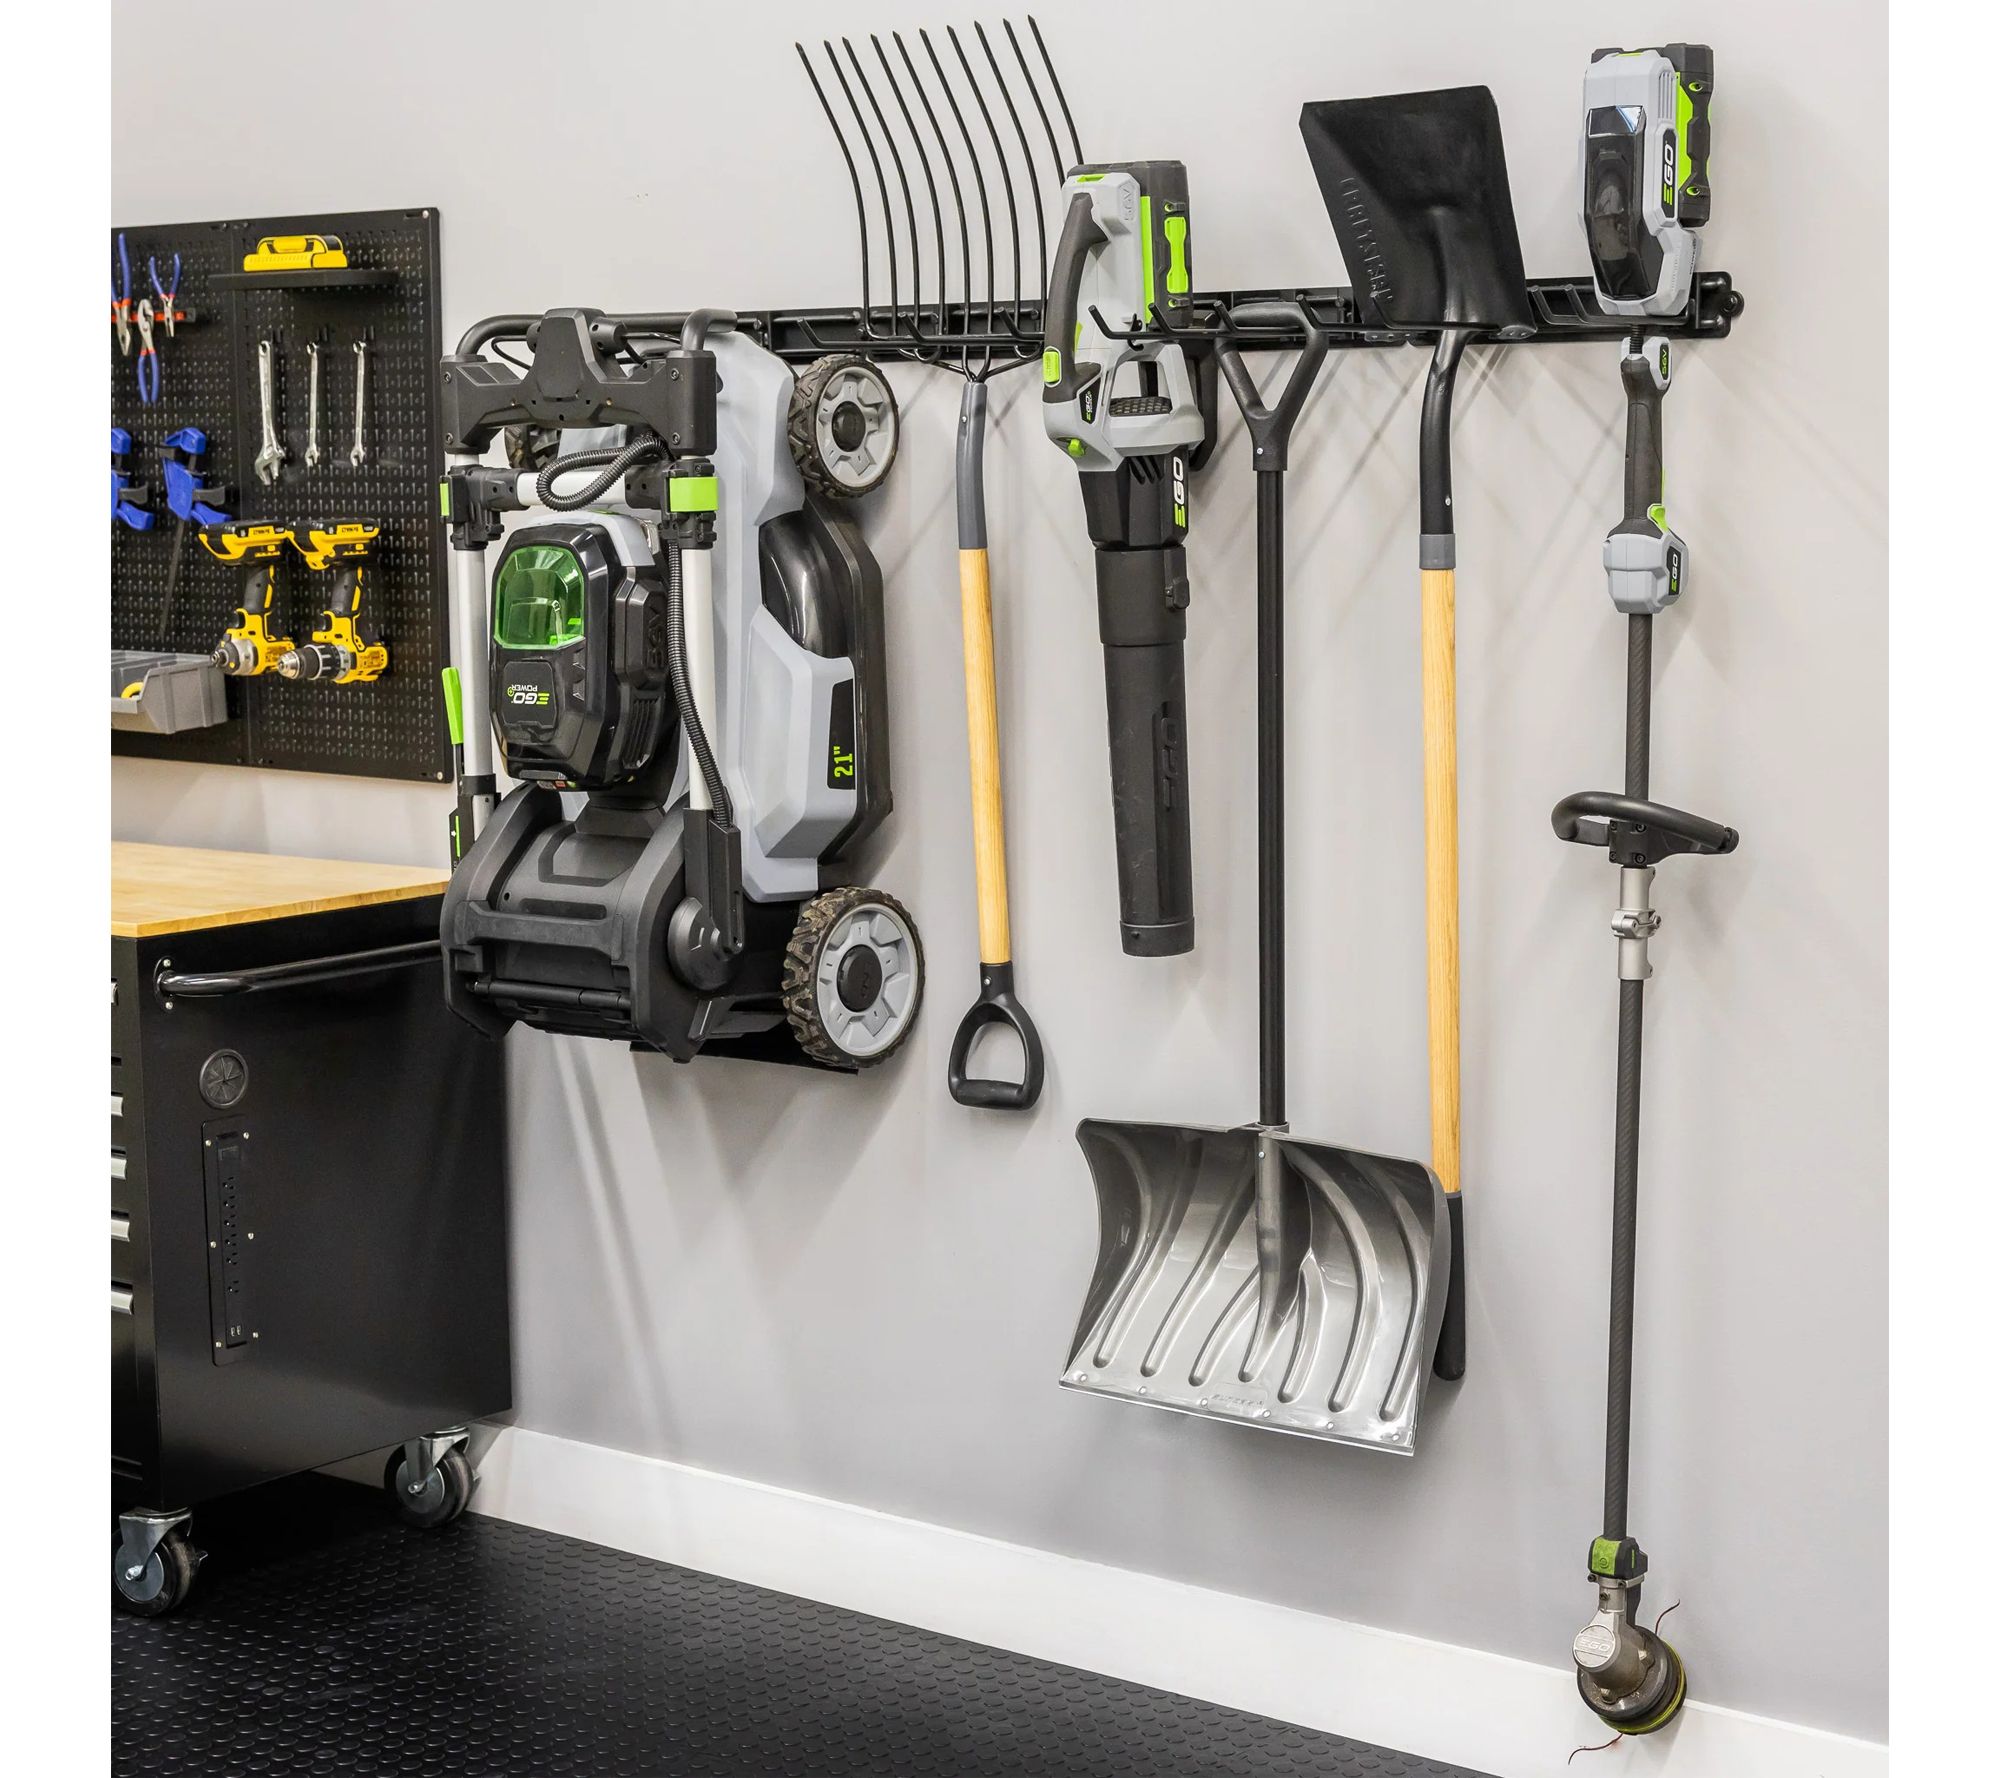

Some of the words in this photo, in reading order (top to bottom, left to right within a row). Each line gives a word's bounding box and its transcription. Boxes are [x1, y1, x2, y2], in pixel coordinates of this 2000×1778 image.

[1664, 143, 1674, 206] EGO
[1173, 456, 1186, 528] EGO
[513, 692, 550, 705] EGO
[833, 745, 854, 778] 21"
